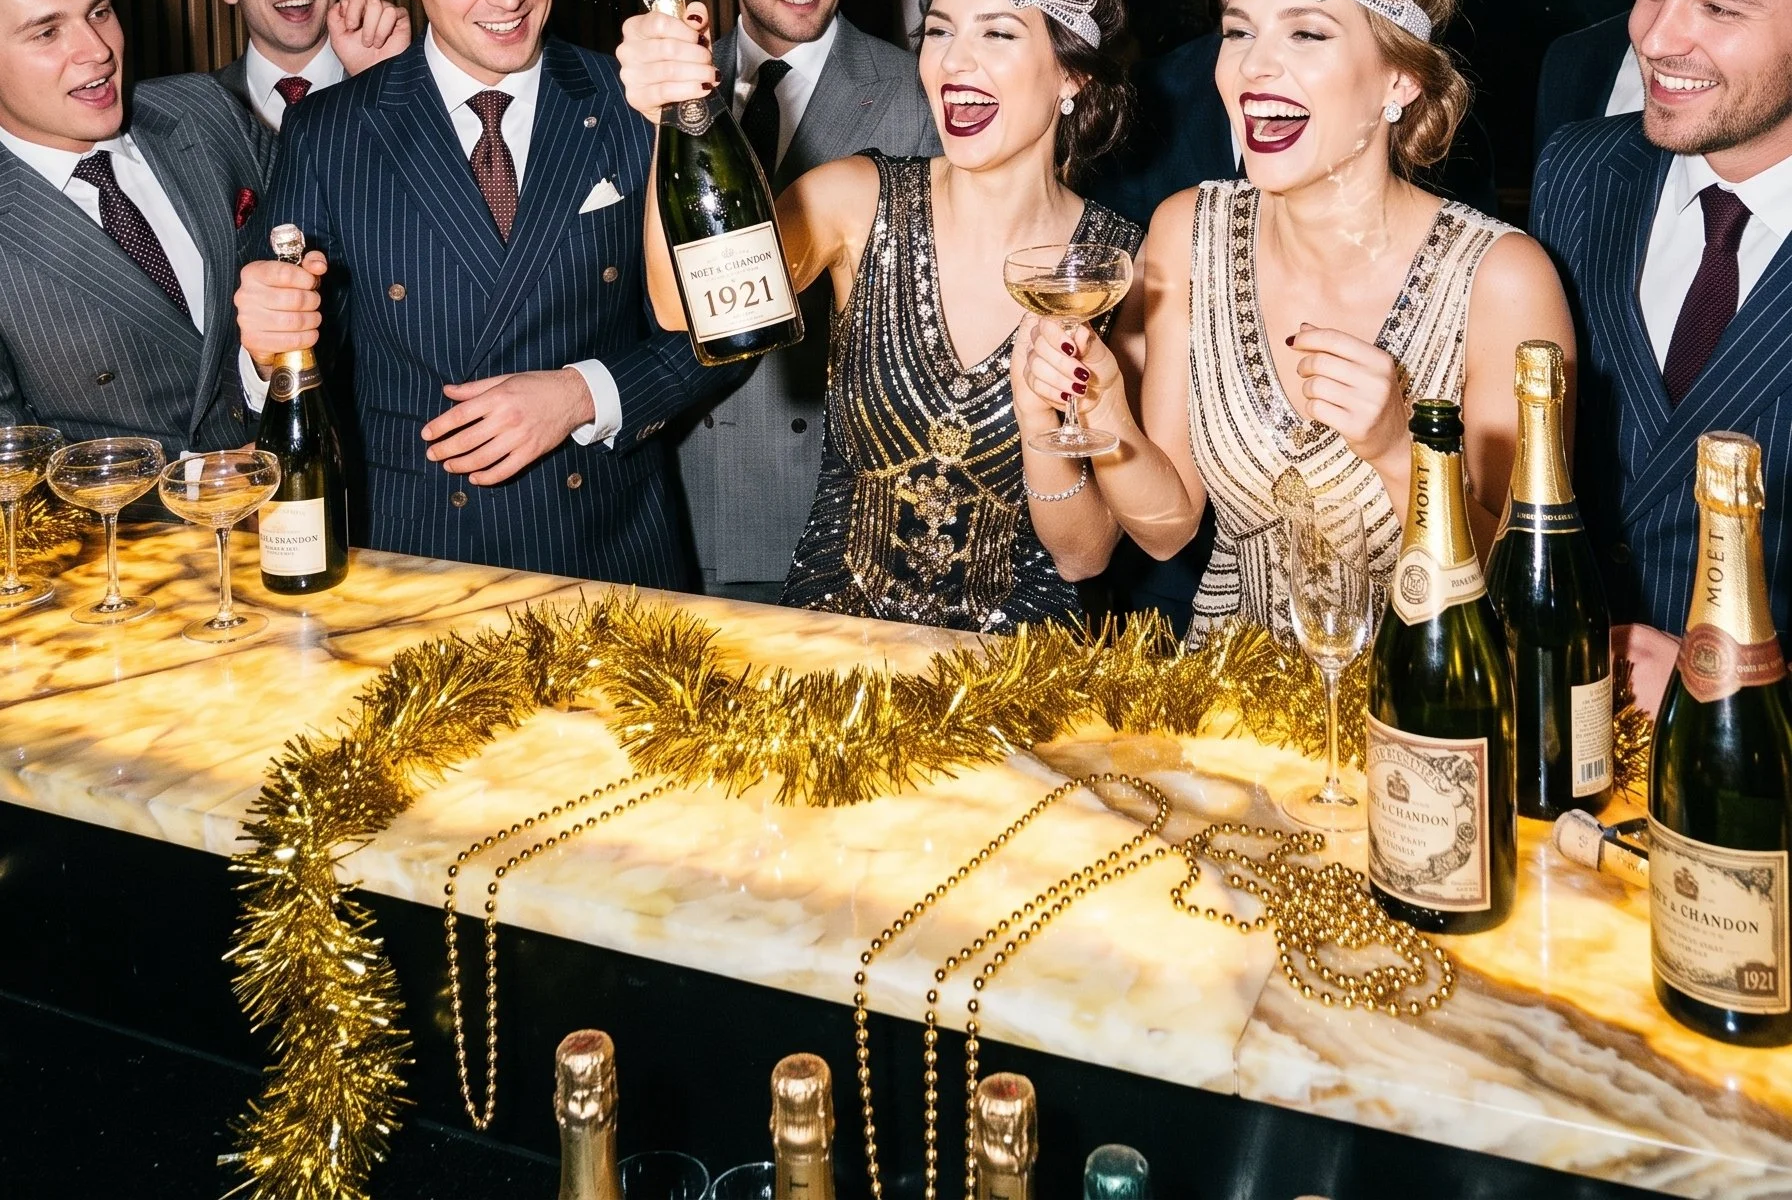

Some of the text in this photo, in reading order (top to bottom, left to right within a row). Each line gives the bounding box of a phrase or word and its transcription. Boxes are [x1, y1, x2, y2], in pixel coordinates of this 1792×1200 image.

[704, 275, 774, 318] 1921
[1707, 529, 1725, 607] MOET
[1388, 802, 1449, 827] CHANDON
[1671, 901, 1677, 912] &
[1681, 903, 1760, 934] CHANDON
[1743, 970, 1775, 991] 1921
